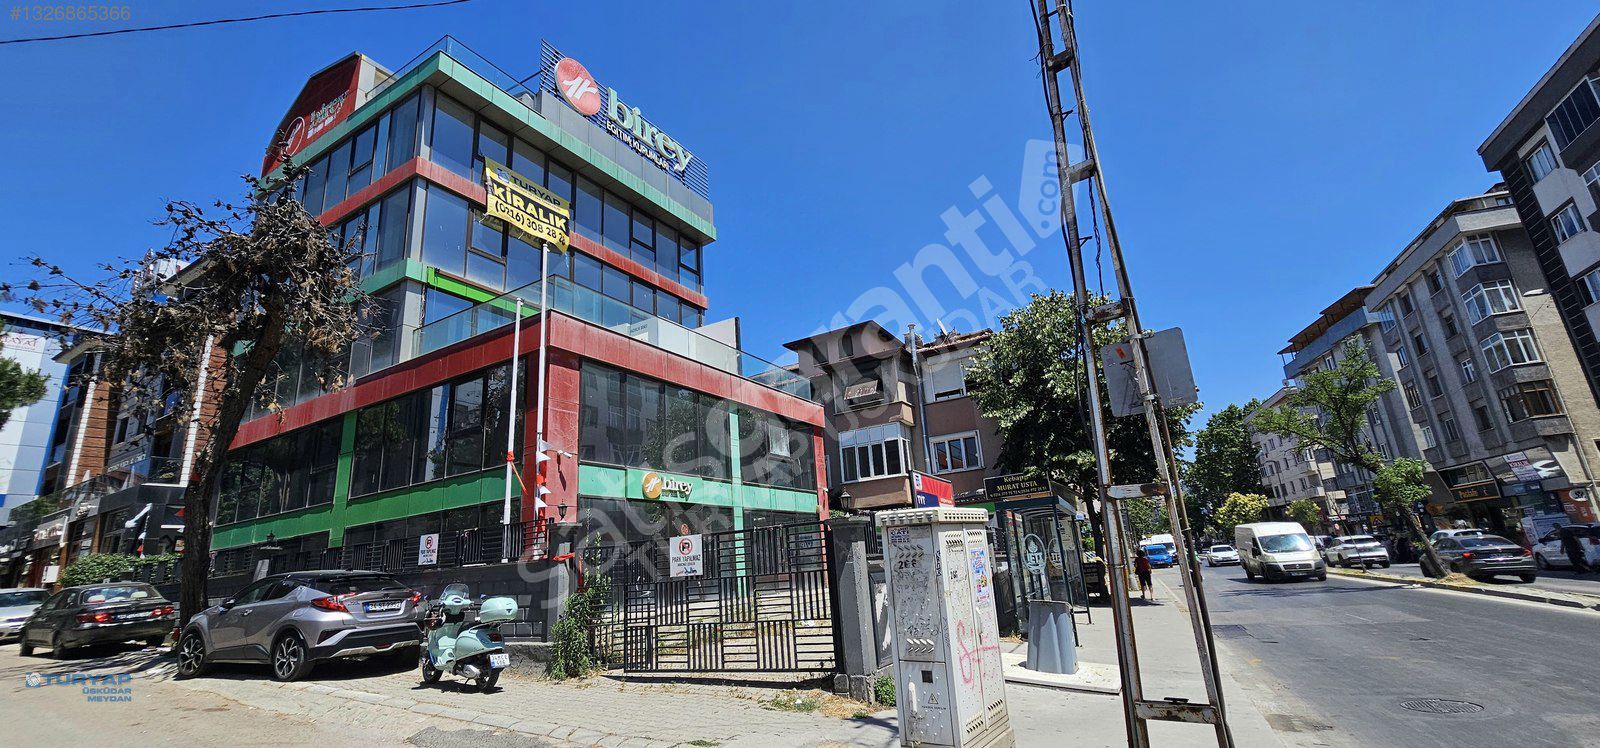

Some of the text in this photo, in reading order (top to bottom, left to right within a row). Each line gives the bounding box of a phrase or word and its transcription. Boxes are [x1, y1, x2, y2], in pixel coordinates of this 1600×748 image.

[608, 87, 692, 172] birey
[493, 183, 567, 233] KİRALIK
[510, 175, 561, 206] TURYAP
[495, 200, 525, 226] (0216)
[527, 218, 544, 233] 308
[546, 227, 557, 239] 28
[661, 476, 693, 495] birey
[996, 482, 1019, 492] MURAT
[1020, 480, 1038, 489] USTA
